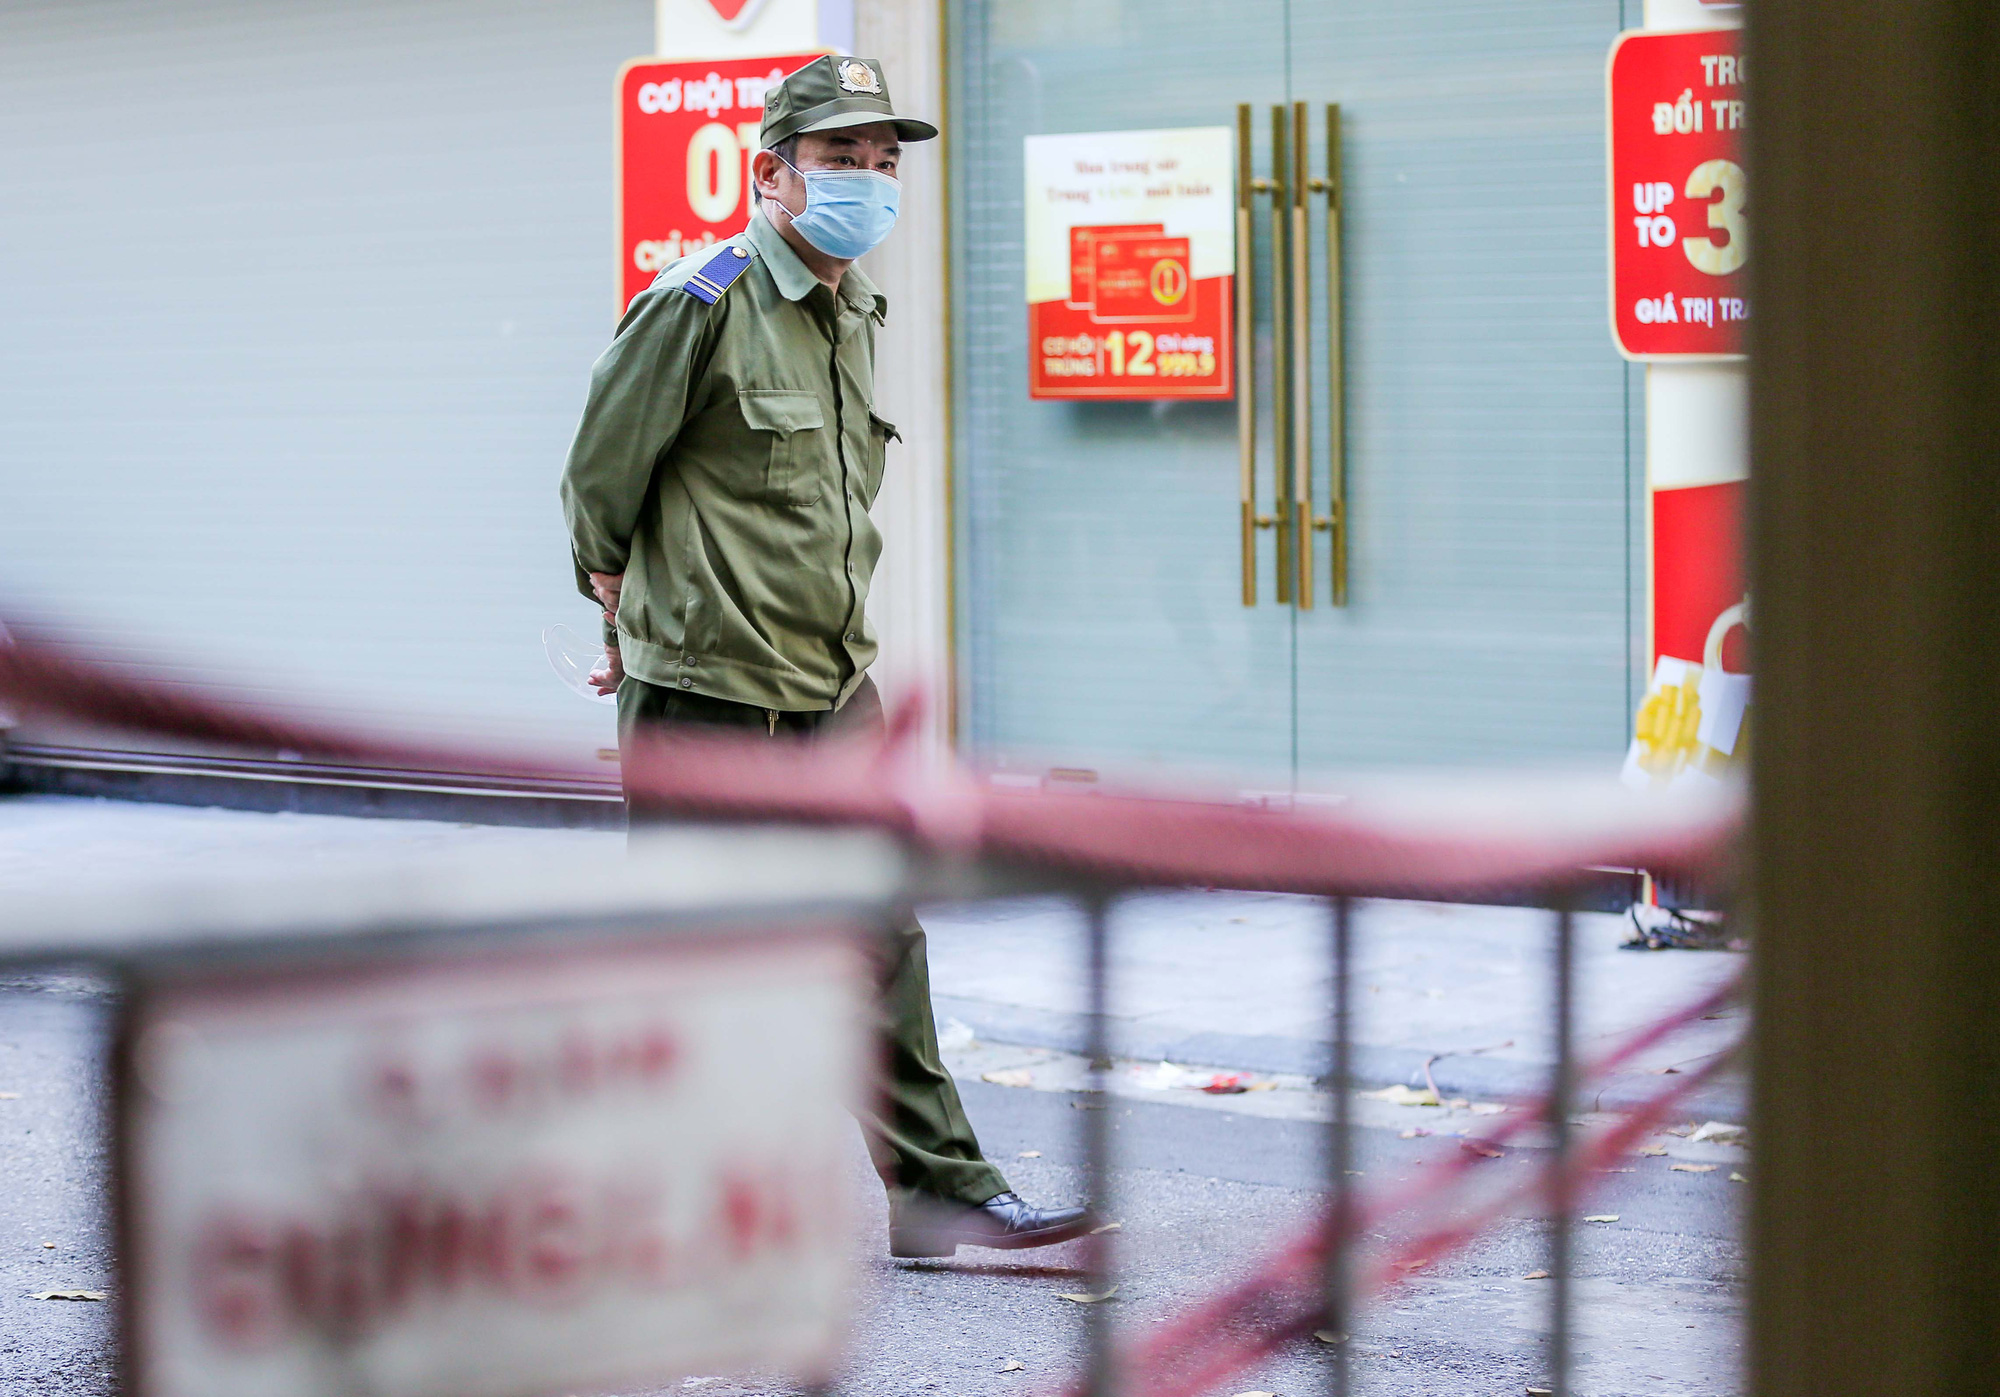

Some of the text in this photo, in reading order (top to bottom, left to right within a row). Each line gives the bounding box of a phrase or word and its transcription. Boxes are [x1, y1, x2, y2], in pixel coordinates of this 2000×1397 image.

[638, 77, 682, 115] CƠ
[683, 71, 733, 118] HỘI
[1634, 182, 1674, 215] UP
[1634, 215, 1676, 248] TO
[1634, 292, 1679, 324] GIÁ
[1681, 297, 1713, 329] TRỊ
[1104, 330, 1156, 376] 12
